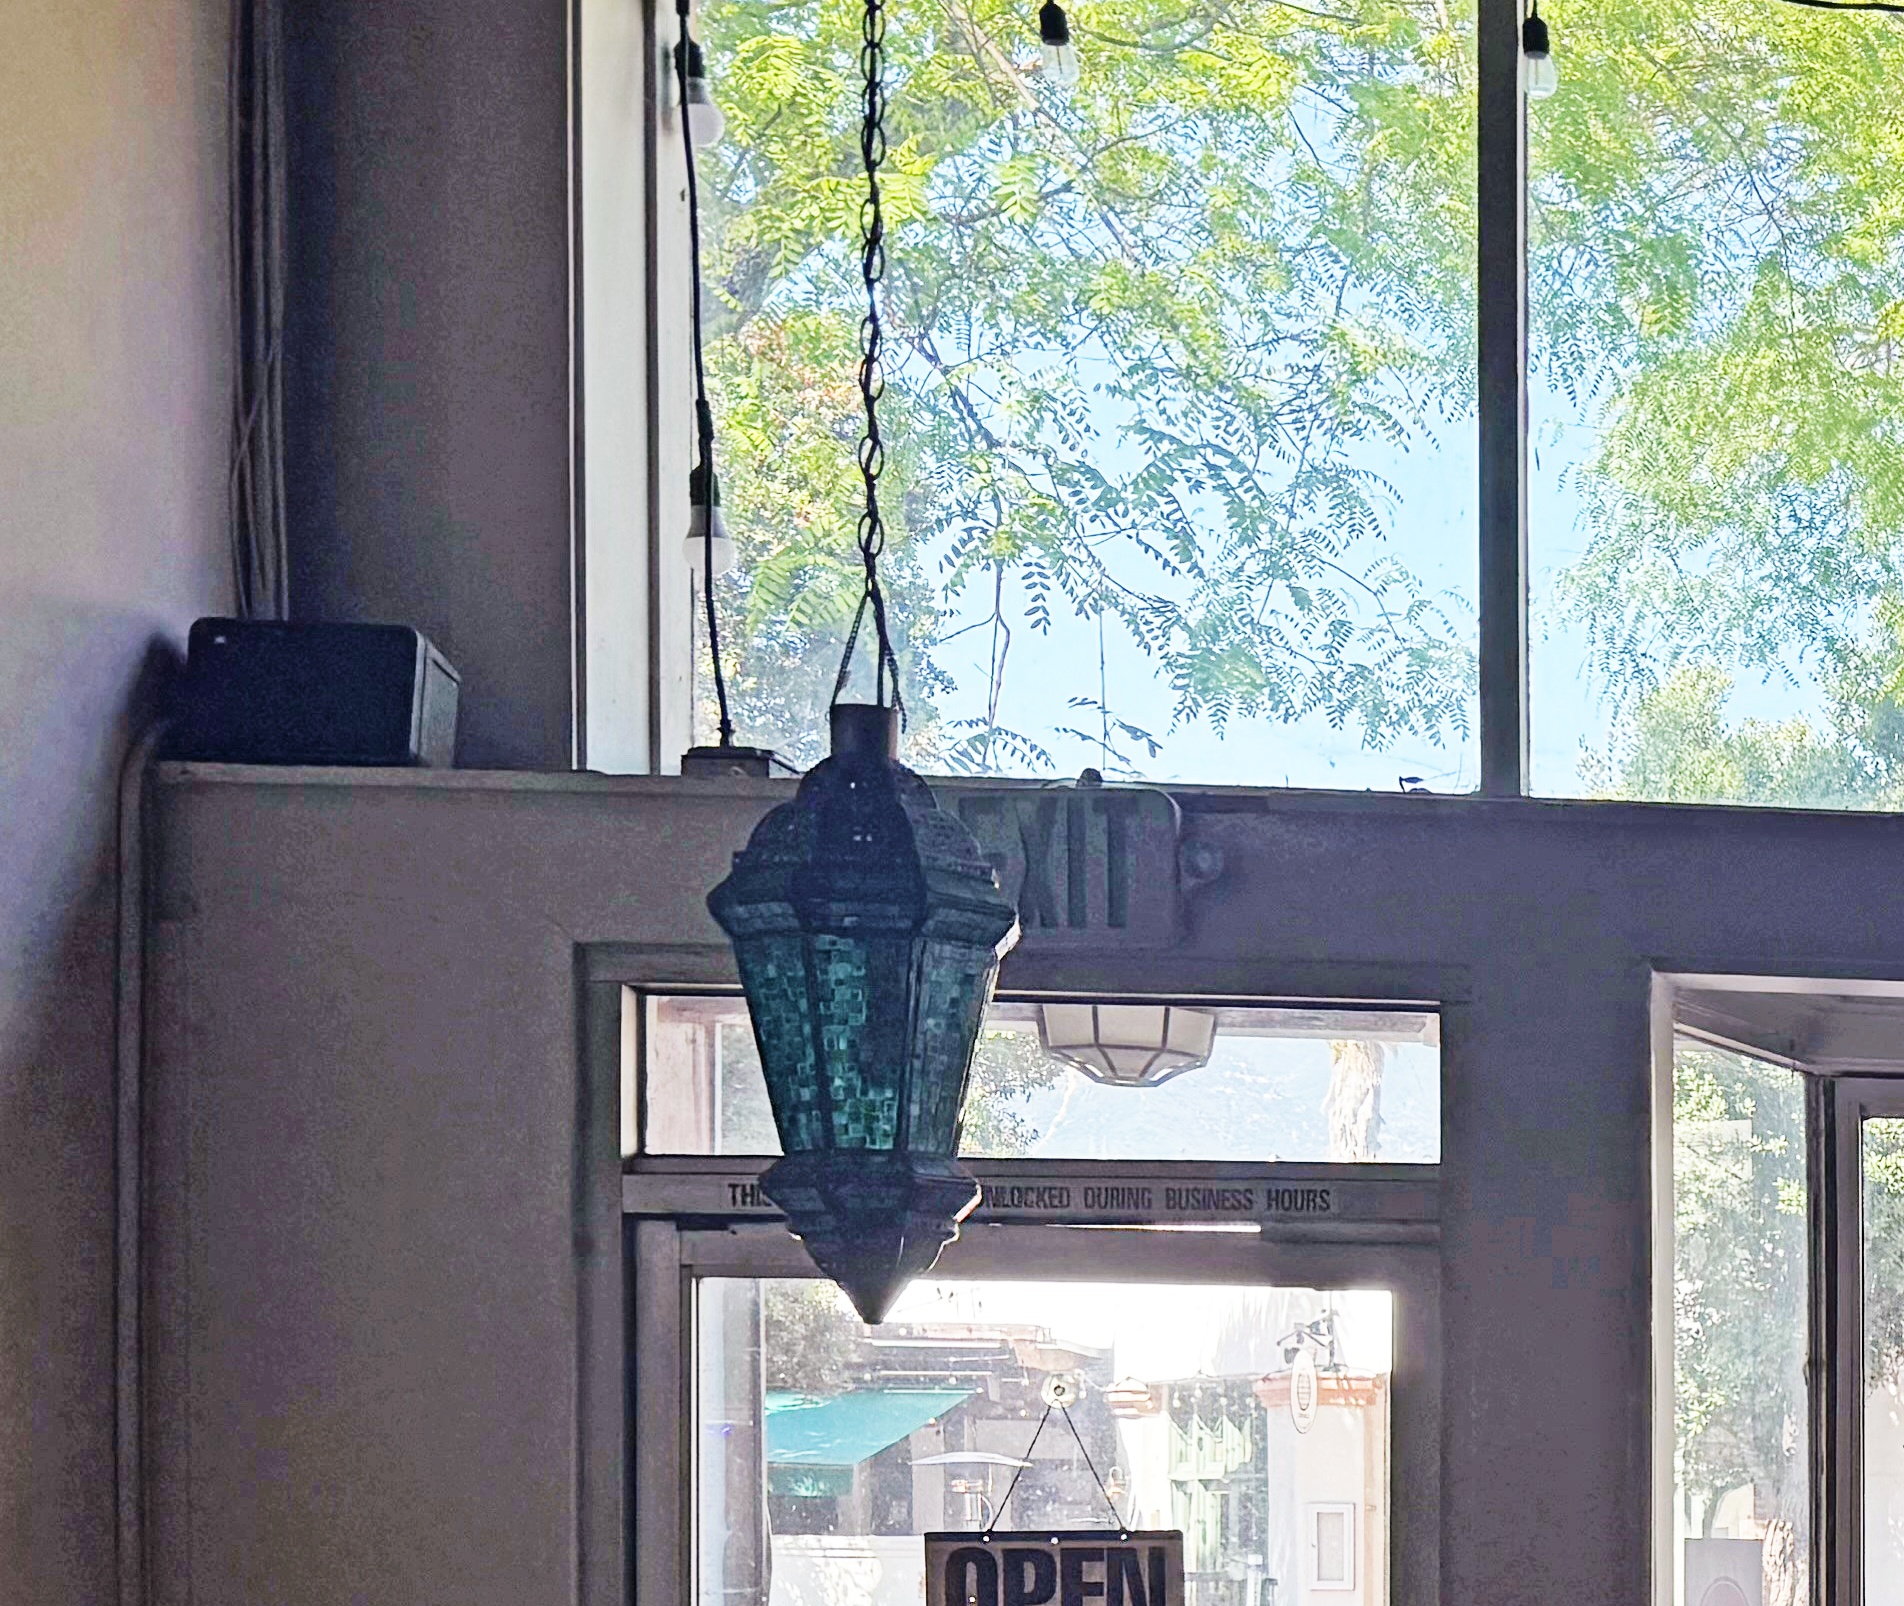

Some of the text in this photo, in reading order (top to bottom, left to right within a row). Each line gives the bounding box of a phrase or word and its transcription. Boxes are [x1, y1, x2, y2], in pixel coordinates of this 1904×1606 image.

[984, 1186, 1070, 1209] NLOCKED
[1084, 1186, 1152, 1210] DURING
[1165, 1187, 1254, 1211] BUSINESS
[1266, 1188, 1331, 1212] HOURS
